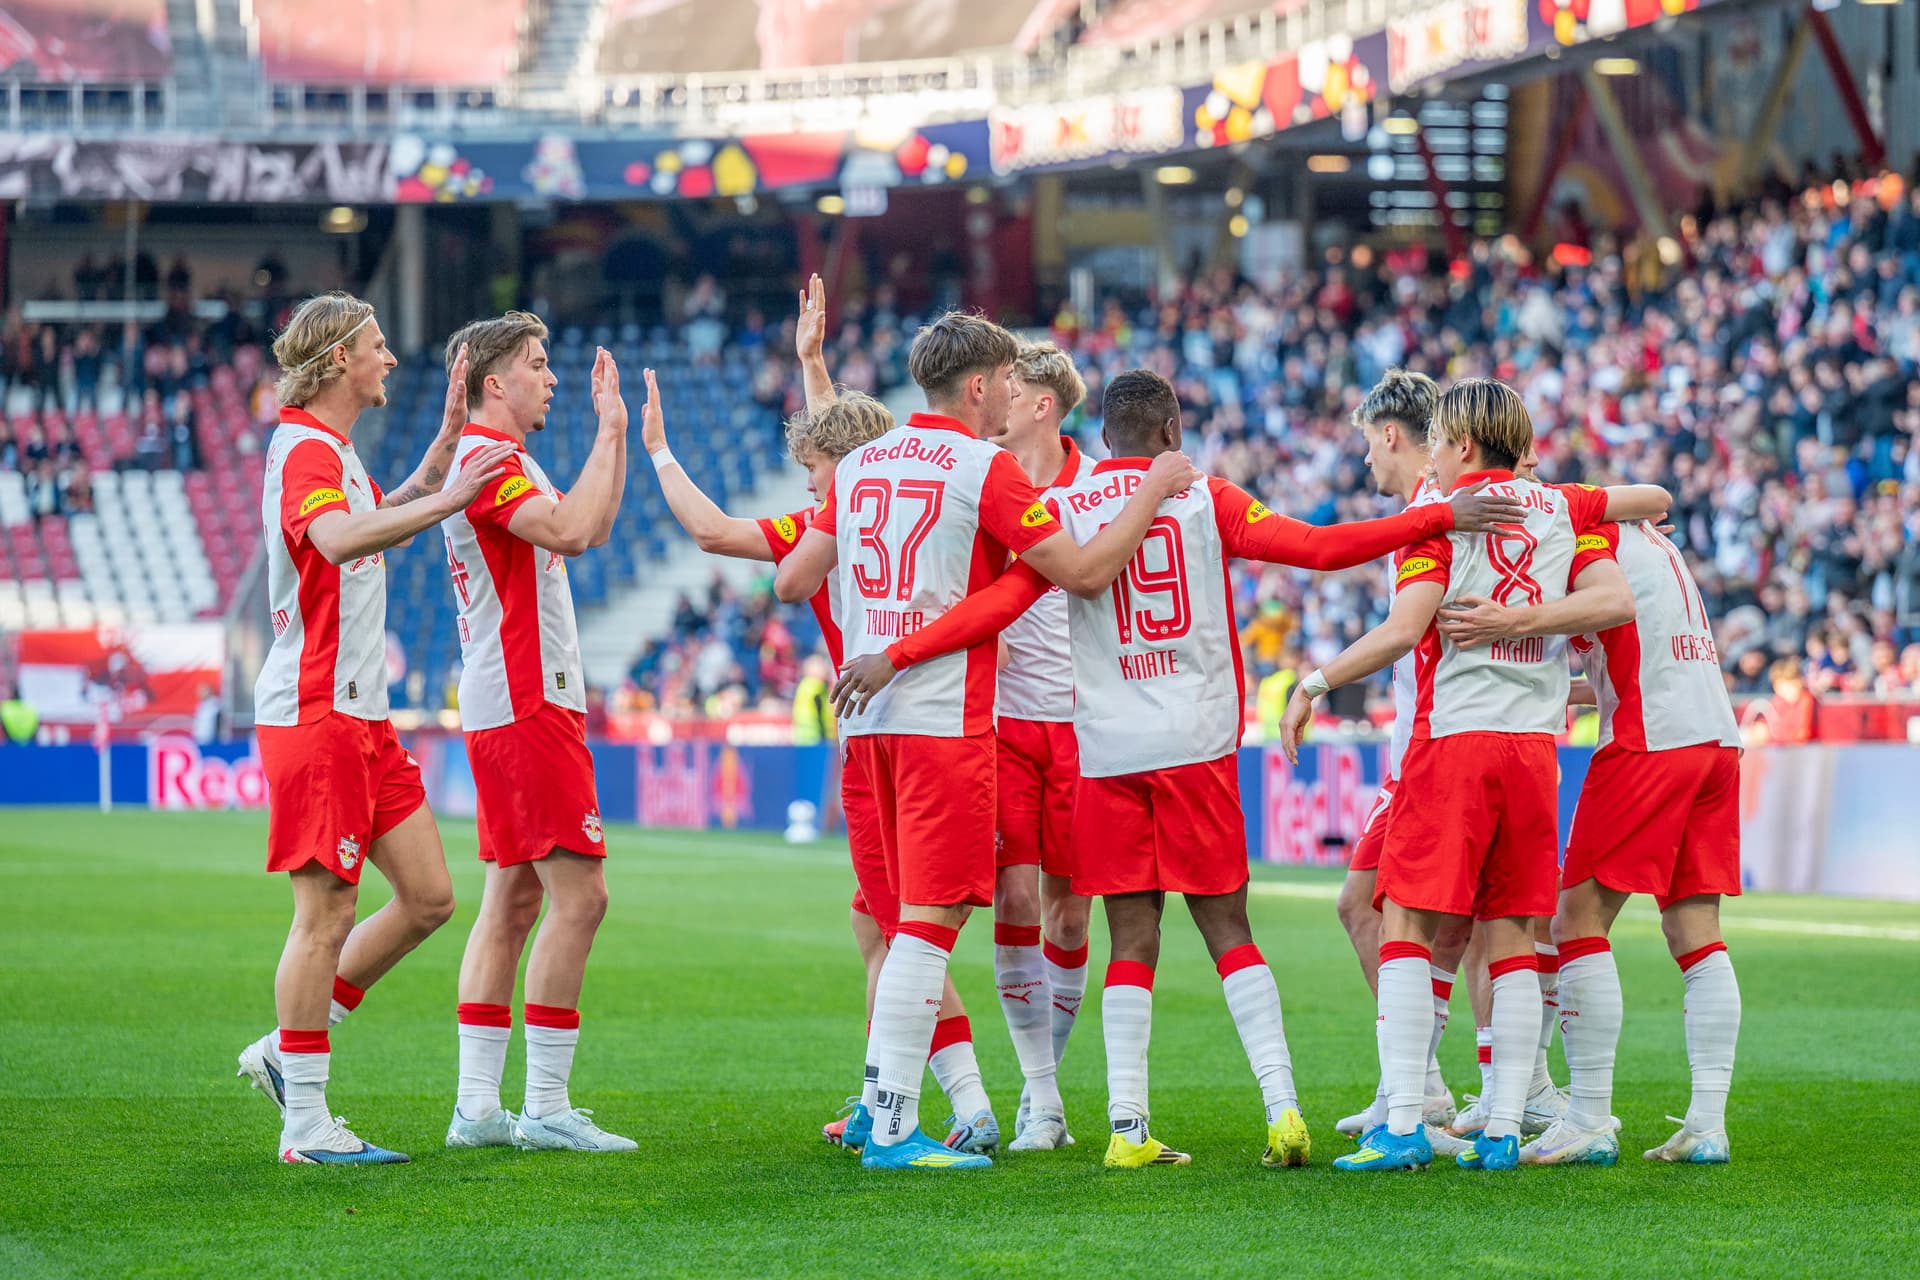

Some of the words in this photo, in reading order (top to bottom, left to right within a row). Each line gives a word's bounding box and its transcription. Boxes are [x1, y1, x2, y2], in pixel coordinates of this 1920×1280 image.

[308, 492, 339, 506] RAUCH
[850, 478, 946, 601] 37
[1099, 516, 1192, 645] 19
[1486, 522, 1544, 607] 8
